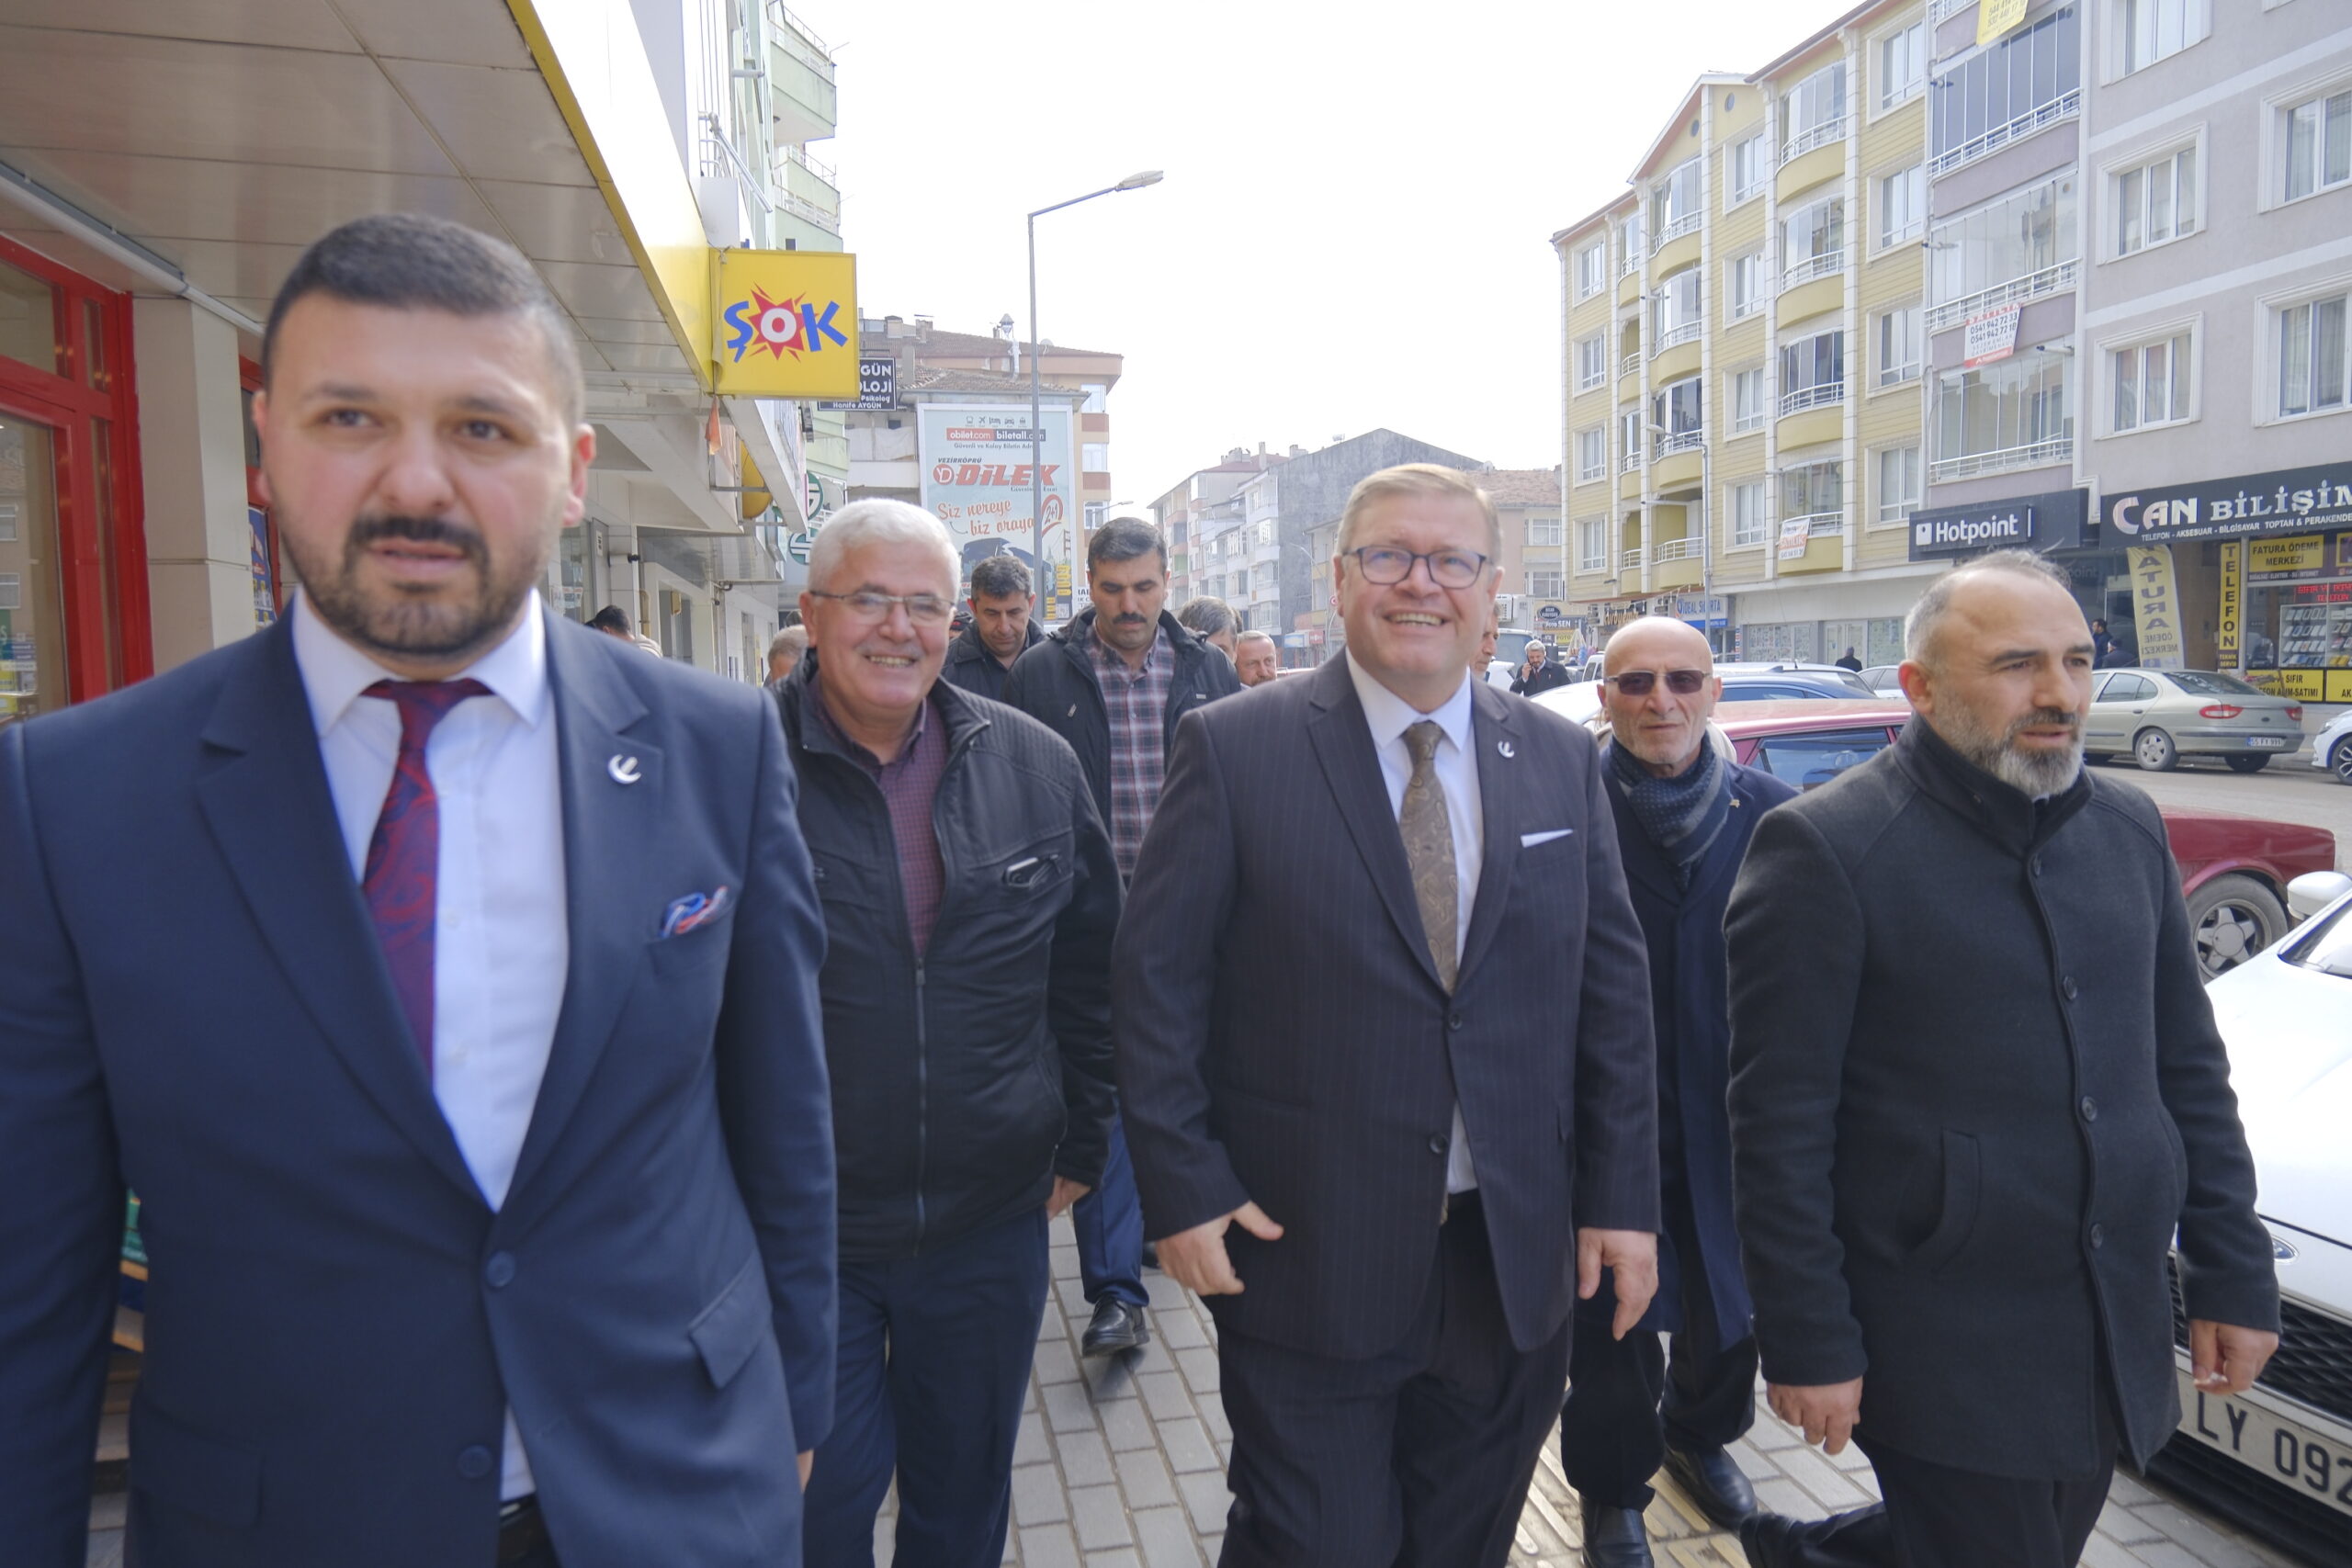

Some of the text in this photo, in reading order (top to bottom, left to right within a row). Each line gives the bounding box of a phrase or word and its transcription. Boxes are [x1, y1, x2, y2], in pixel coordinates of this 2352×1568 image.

[724, 300, 848, 363] ŞOK
[1971, 323, 1985, 334] 0541
[1971, 333, 1985, 344] 0541
[859, 362, 891, 376] GÜN
[859, 378, 892, 393] LOJİ
[996, 430, 1045, 441] biletall.cm
[956, 464, 1060, 486] DİLEK
[938, 500, 1012, 520] Siz nereye
[2113, 496, 2198, 535] CAN
[969, 517, 1035, 536] biz oraya
[1936, 513, 2019, 545] Hotpoint
[2142, 532, 2170, 542] TELEFON
[2176, 528, 2213, 538] AKSESUAR
[2219, 522, 2260, 534] BİLGİSAYAR
[2265, 519, 2294, 529] TOPTAN
[2304, 513, 2352, 525] PERAKENDE
[2253, 541, 2319, 555] FATURA ÖDEME
[2266, 554, 2304, 566] MERKEZİ
[2222, 546, 2236, 647] TELEFON
[2286, 674, 2303, 683] SIFIR
